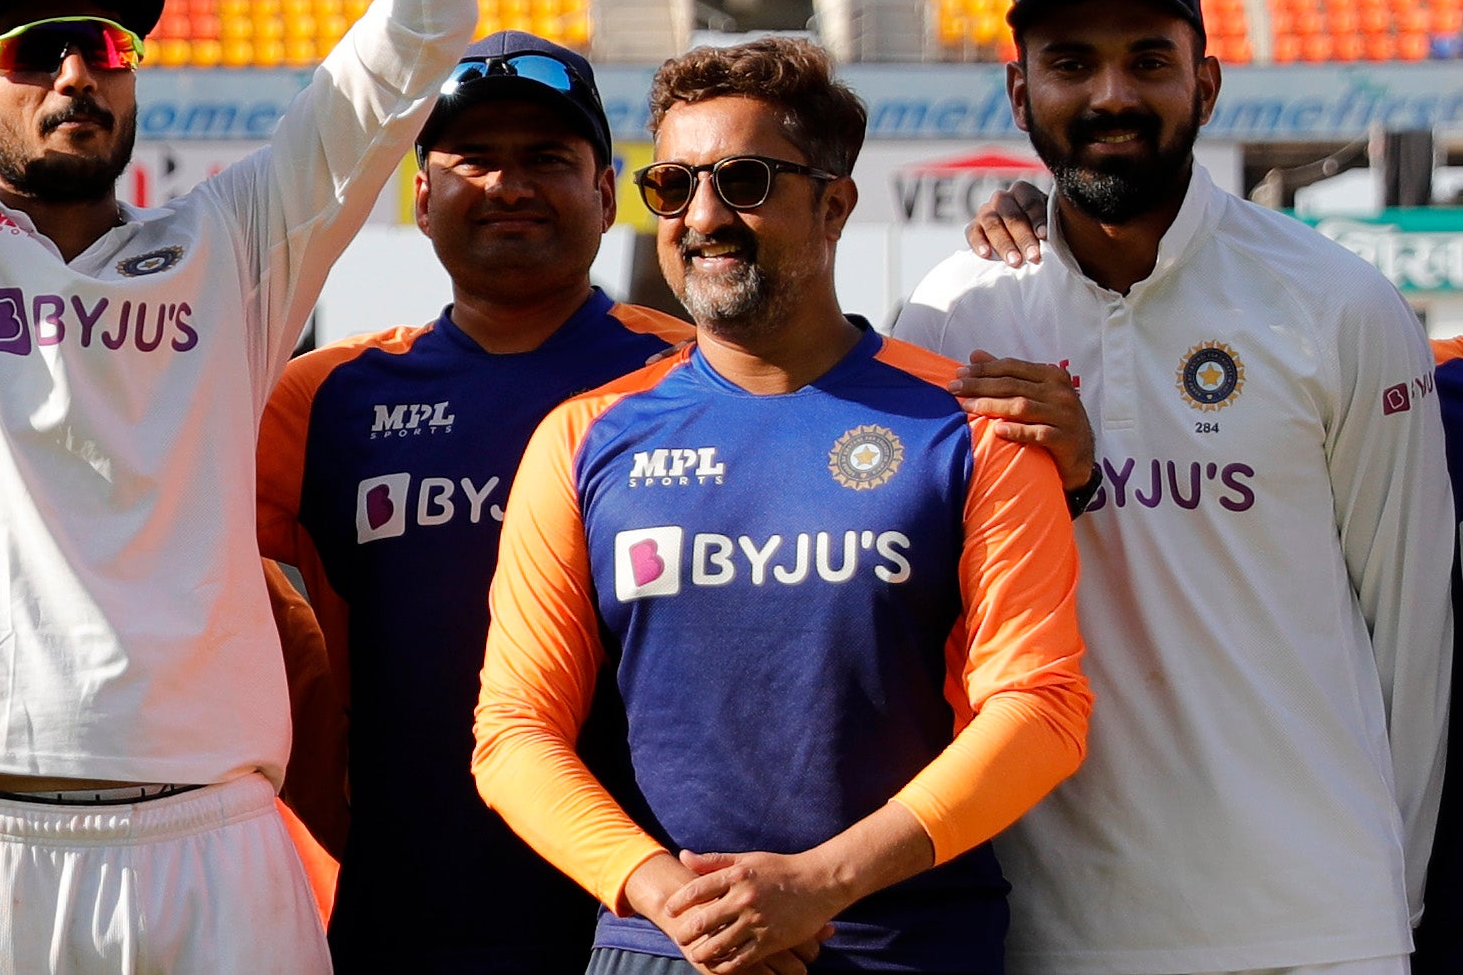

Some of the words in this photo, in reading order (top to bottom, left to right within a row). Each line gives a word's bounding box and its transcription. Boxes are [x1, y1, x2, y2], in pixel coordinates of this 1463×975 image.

[33, 294, 199, 353] BYJU'S
[371, 401, 456, 432] MPL
[1195, 421, 1220, 434] 284
[369, 425, 453, 440] SPORTS
[629, 446, 726, 478] MPL
[628, 475, 724, 488] SPORTS
[691, 530, 912, 587] BYJU'S
